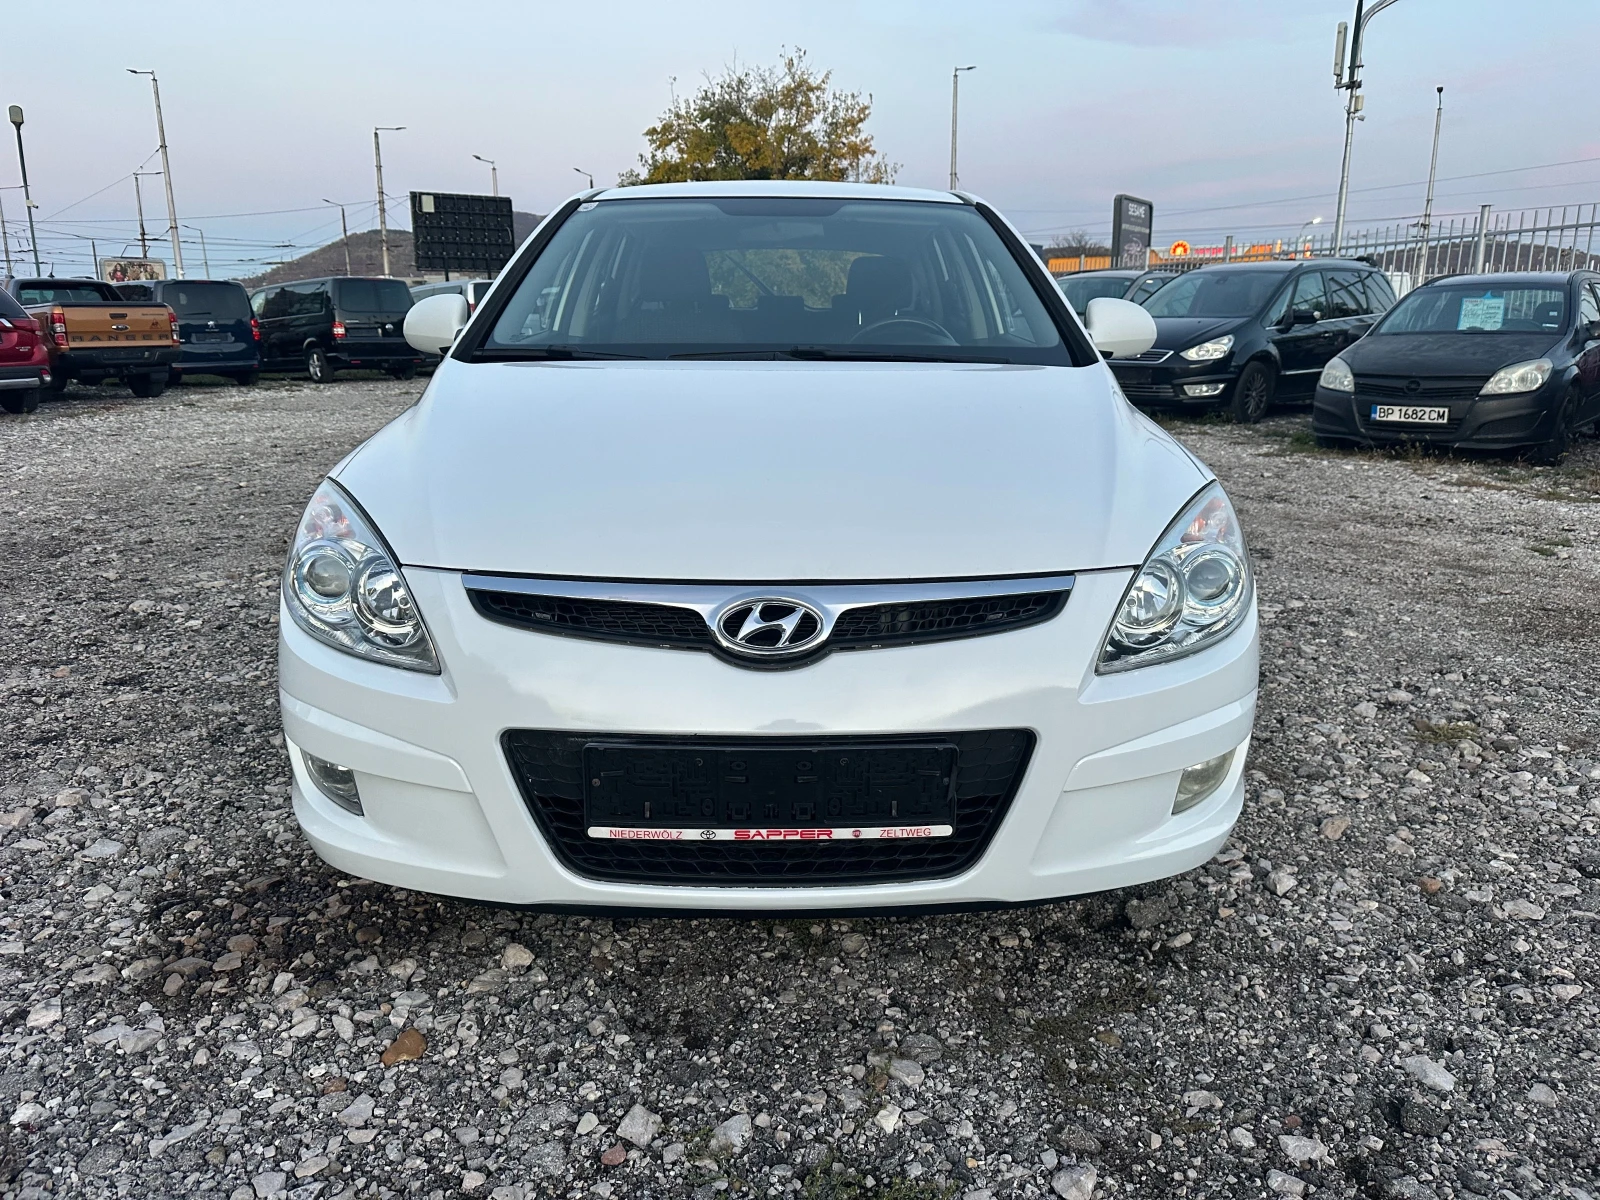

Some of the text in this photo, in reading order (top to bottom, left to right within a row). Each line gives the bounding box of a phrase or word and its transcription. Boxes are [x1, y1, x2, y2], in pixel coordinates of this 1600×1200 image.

[1378, 407, 1446, 421] BP 1682 CM
[609, 828, 932, 840] NIEDERWÖLZ SAPPER ZELTWEG
